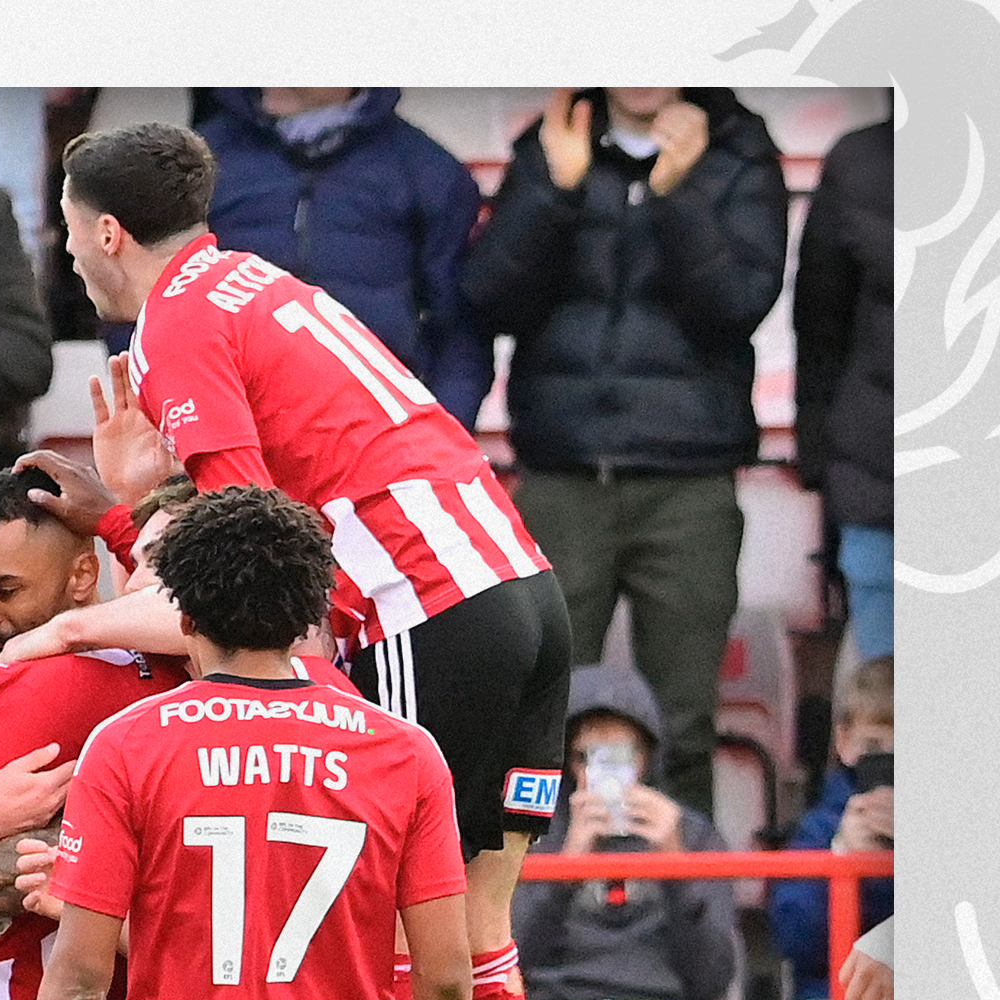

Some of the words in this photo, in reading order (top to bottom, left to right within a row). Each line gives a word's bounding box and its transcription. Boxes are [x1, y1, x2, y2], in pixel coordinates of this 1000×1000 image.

[272, 289, 437, 424] 10
[198, 744, 348, 790] WATTS
[512, 776, 558, 805] EM
[183, 812, 368, 985] 17
